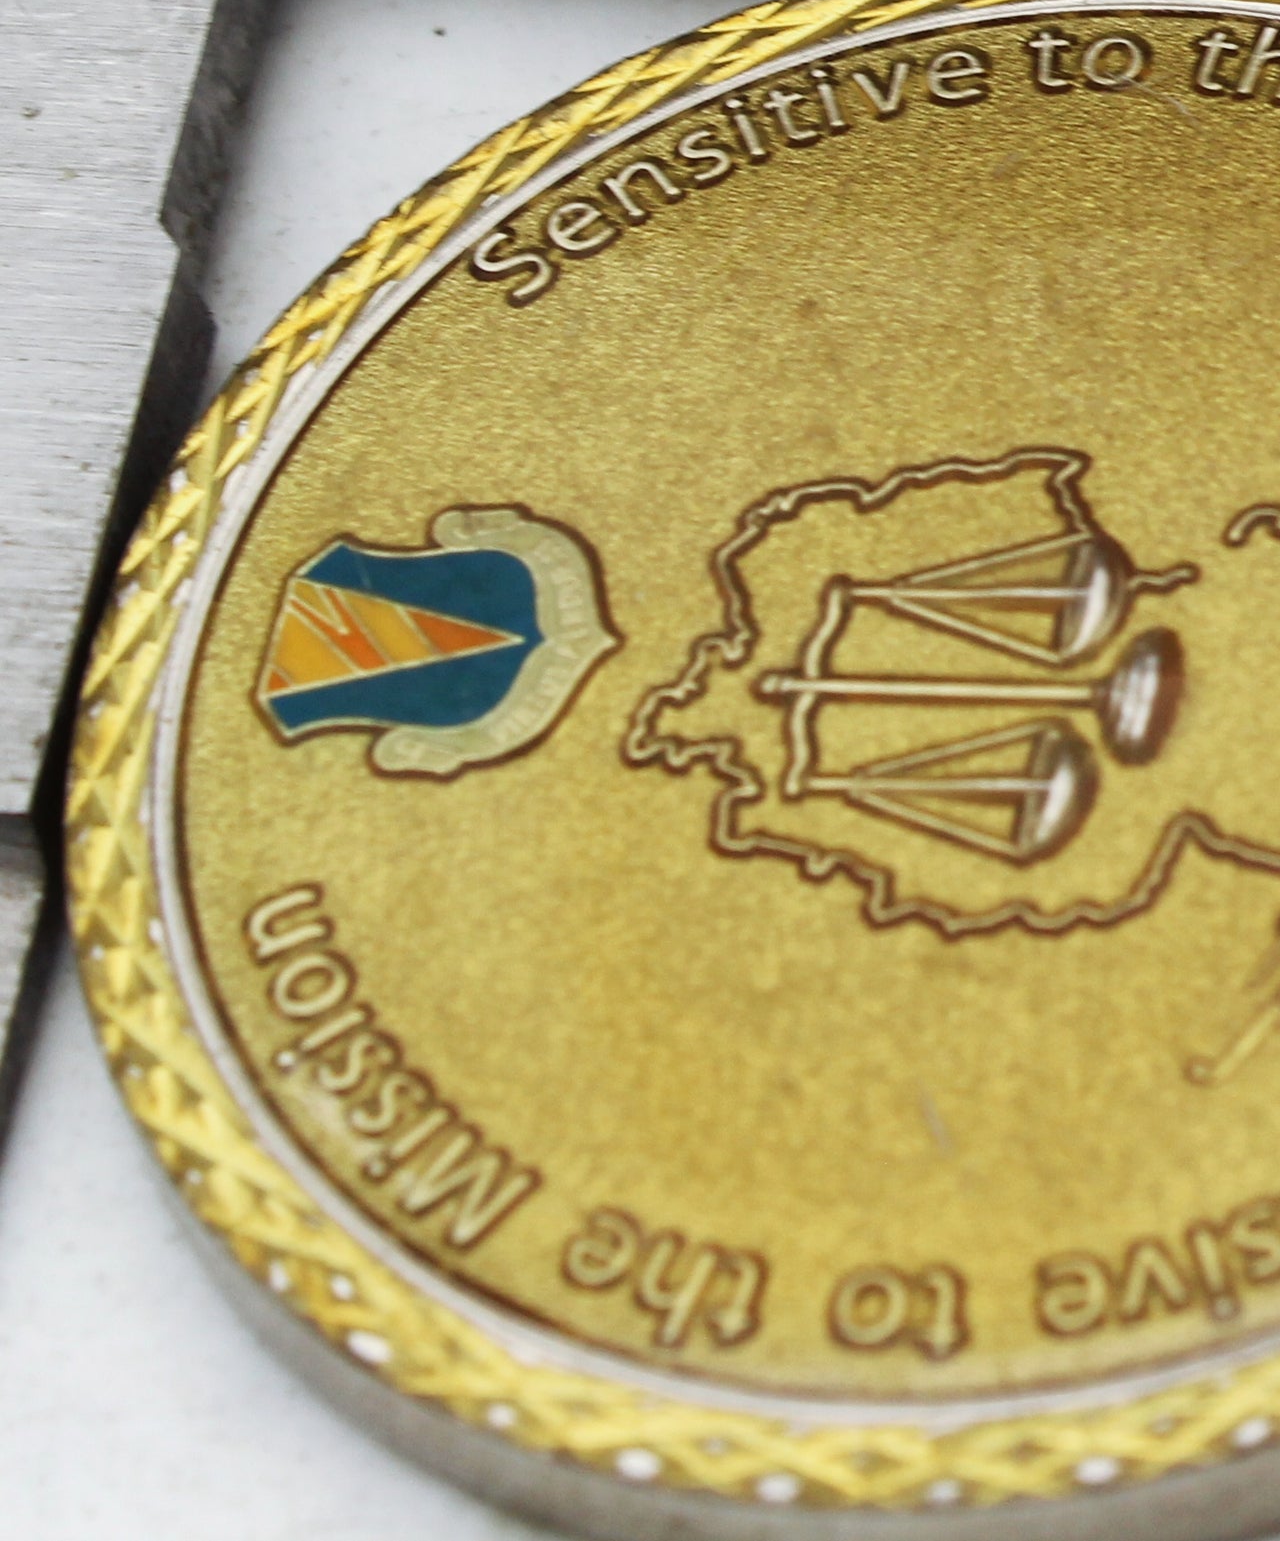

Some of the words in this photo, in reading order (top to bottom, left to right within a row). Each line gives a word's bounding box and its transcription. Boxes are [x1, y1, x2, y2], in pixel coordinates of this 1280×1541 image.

[471, 44, 994, 306] Sensitive
[1023, 24, 1154, 91] to
[244, 881, 543, 1250] Mission
[559, 1205, 769, 1350] the
[829, 1263, 968, 1362] to
